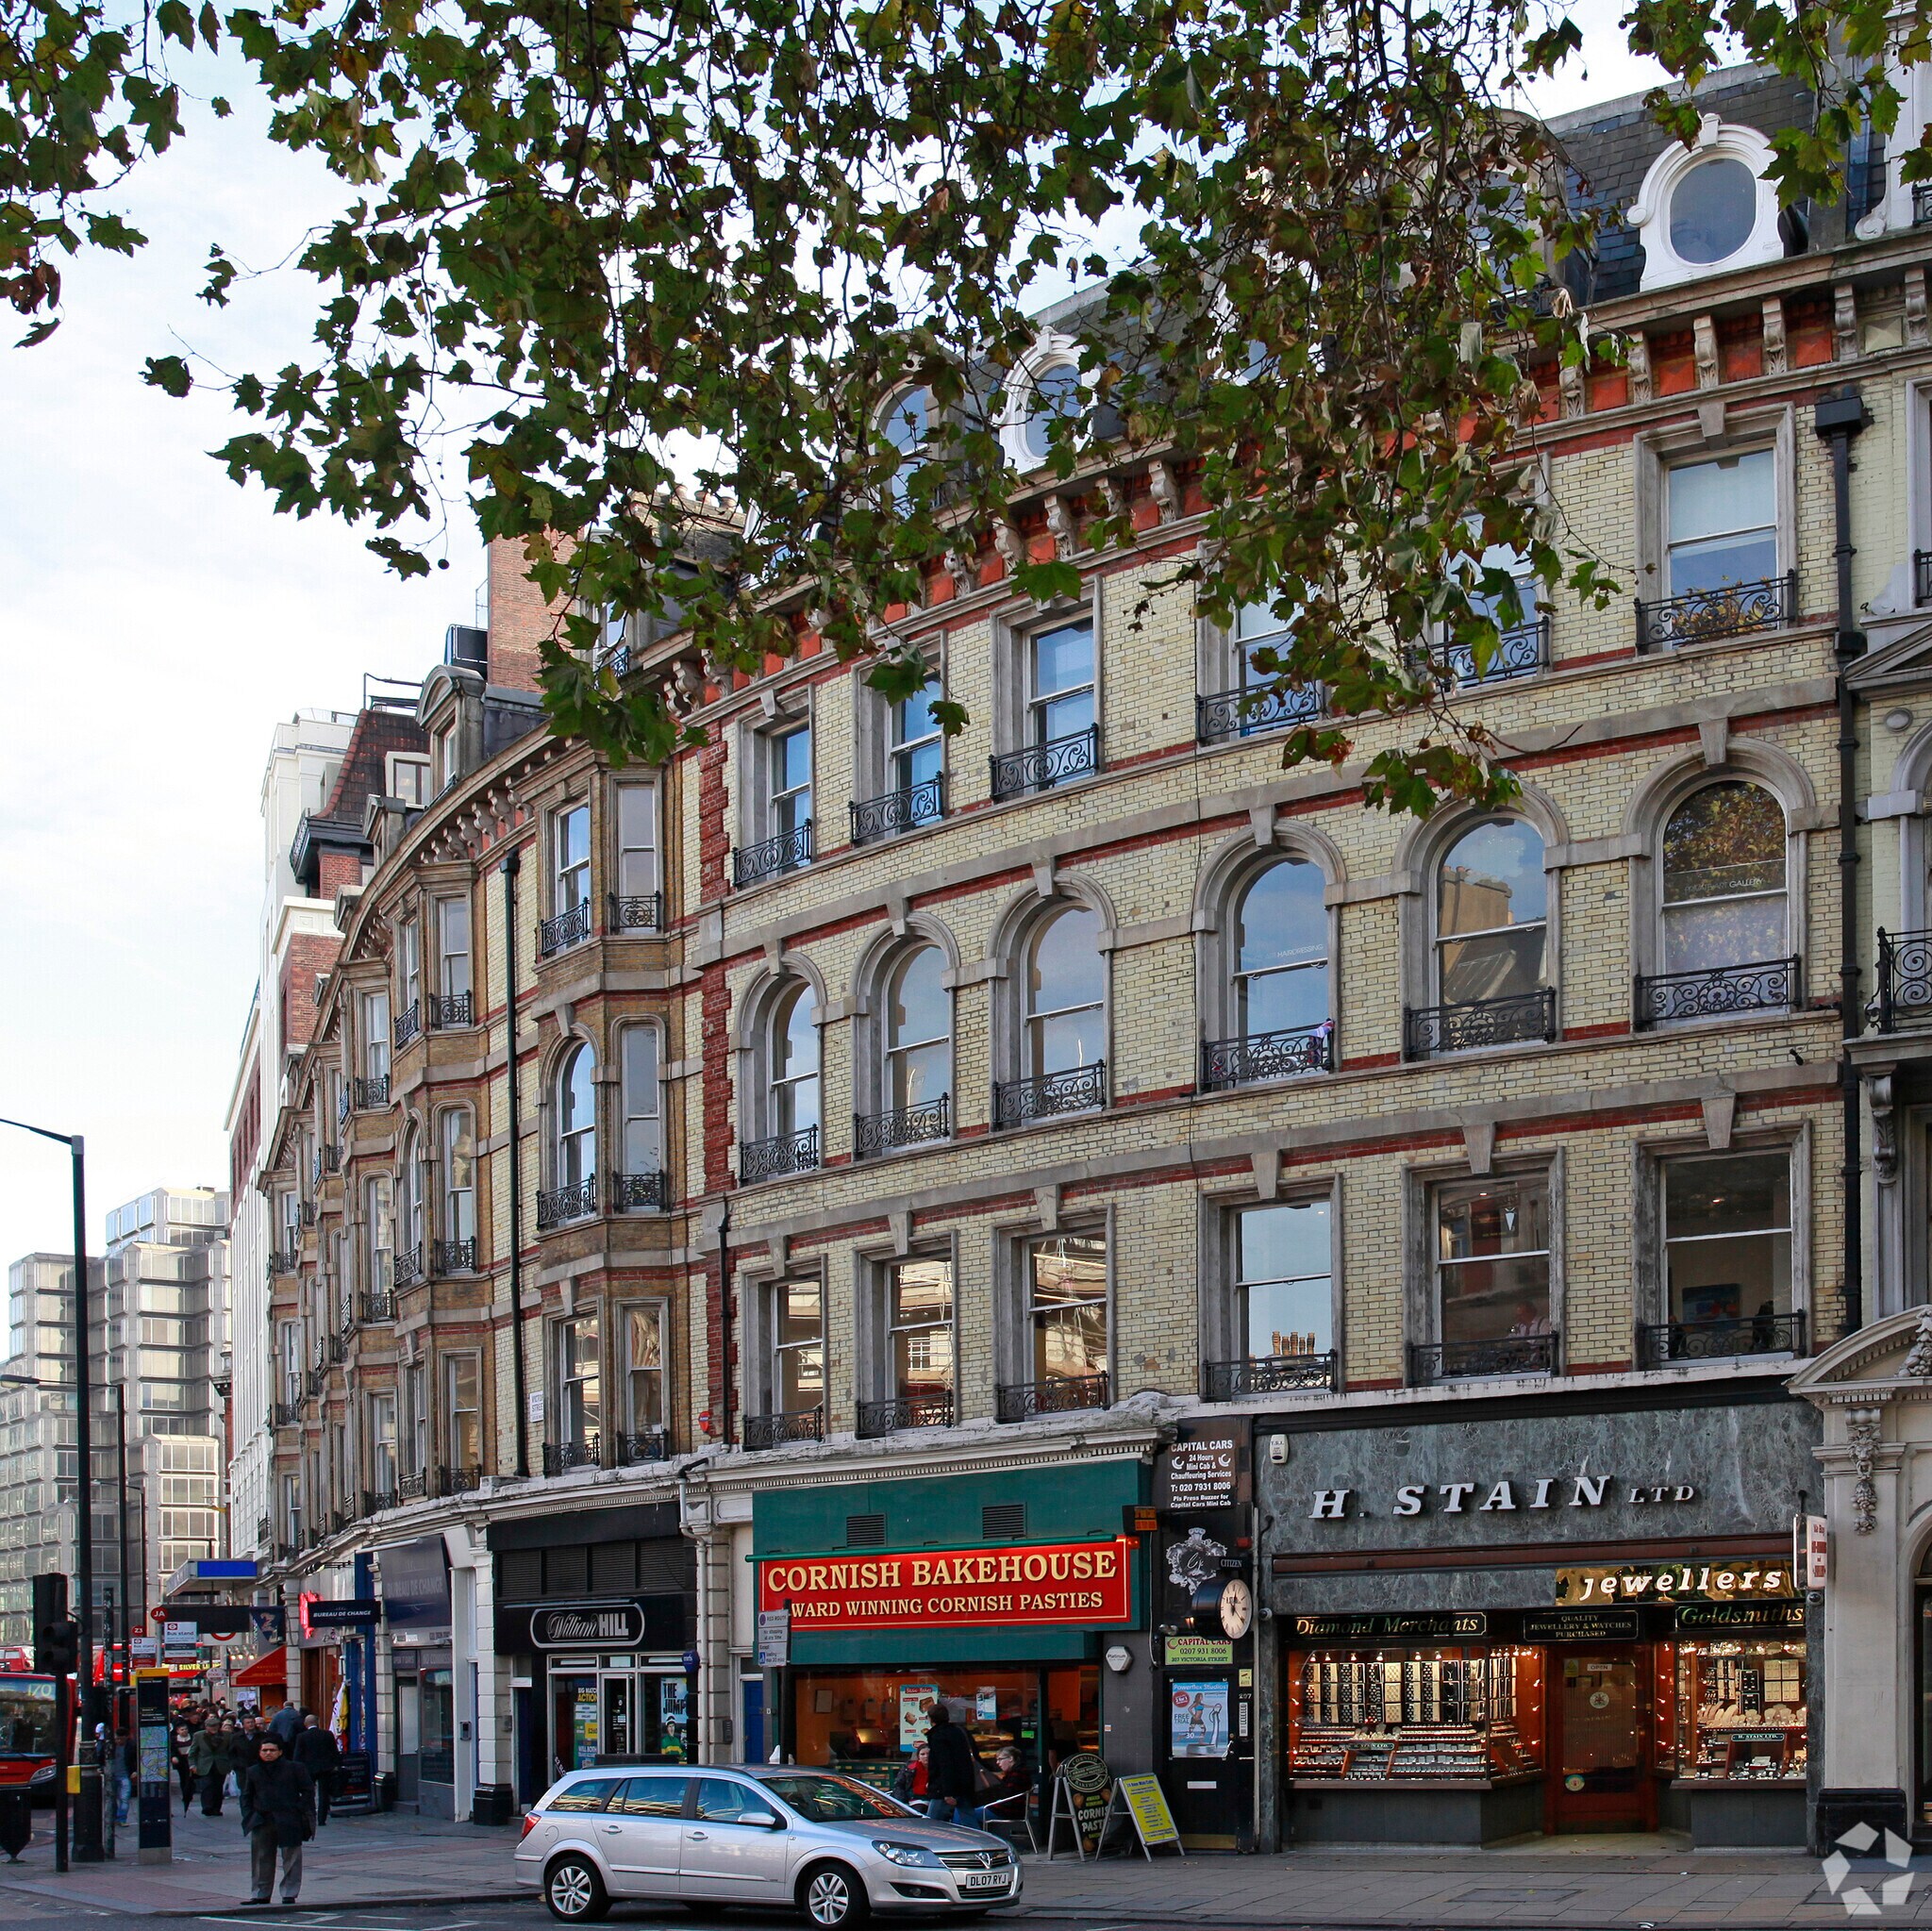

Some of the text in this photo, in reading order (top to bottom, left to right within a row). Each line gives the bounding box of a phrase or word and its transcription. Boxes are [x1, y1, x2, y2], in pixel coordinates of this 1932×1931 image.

[1729, 877, 1764, 888] GALLERY
[1276, 944, 1324, 957] HAIRDRESSING
[531, 1403, 543, 1412] STREE
[1171, 1440, 1233, 1453] CAPITAL CARS
[1171, 1470, 1232, 1480] Chauffeuring Services
[1179, 1483, 1192, 1491] 020
[1194, 1482, 1211, 1490] 7931
[1213, 1481, 1231, 1490] 8006
[1307, 1474, 1695, 1519] H. STAIN LTD
[1220, 1558, 1242, 1568] CITIZEN
[768, 1550, 1117, 1592] CORNISH BAKEHOUSE
[791, 1591, 1103, 1618] WARD WINNING CORNISH PASTIES
[154, 1609, 166, 1618] JA
[1681, 1604, 1804, 1625] Goldsmiths
[546, 1611, 629, 1640] William HILL
[1296, 1616, 1478, 1635] Diamond Merchants
[1177, 1638, 1210, 1646] CAPITAL
[27, 1684, 52, 1697] 170
[662, 1682, 678, 1699] THE
[662, 1698, 687, 1715] JUMP
[1077, 1806, 1108, 1821] CORNIS
[1081, 1821, 1104, 1833] PAST
[971, 1873, 1007, 1886] DL07 RYJ
